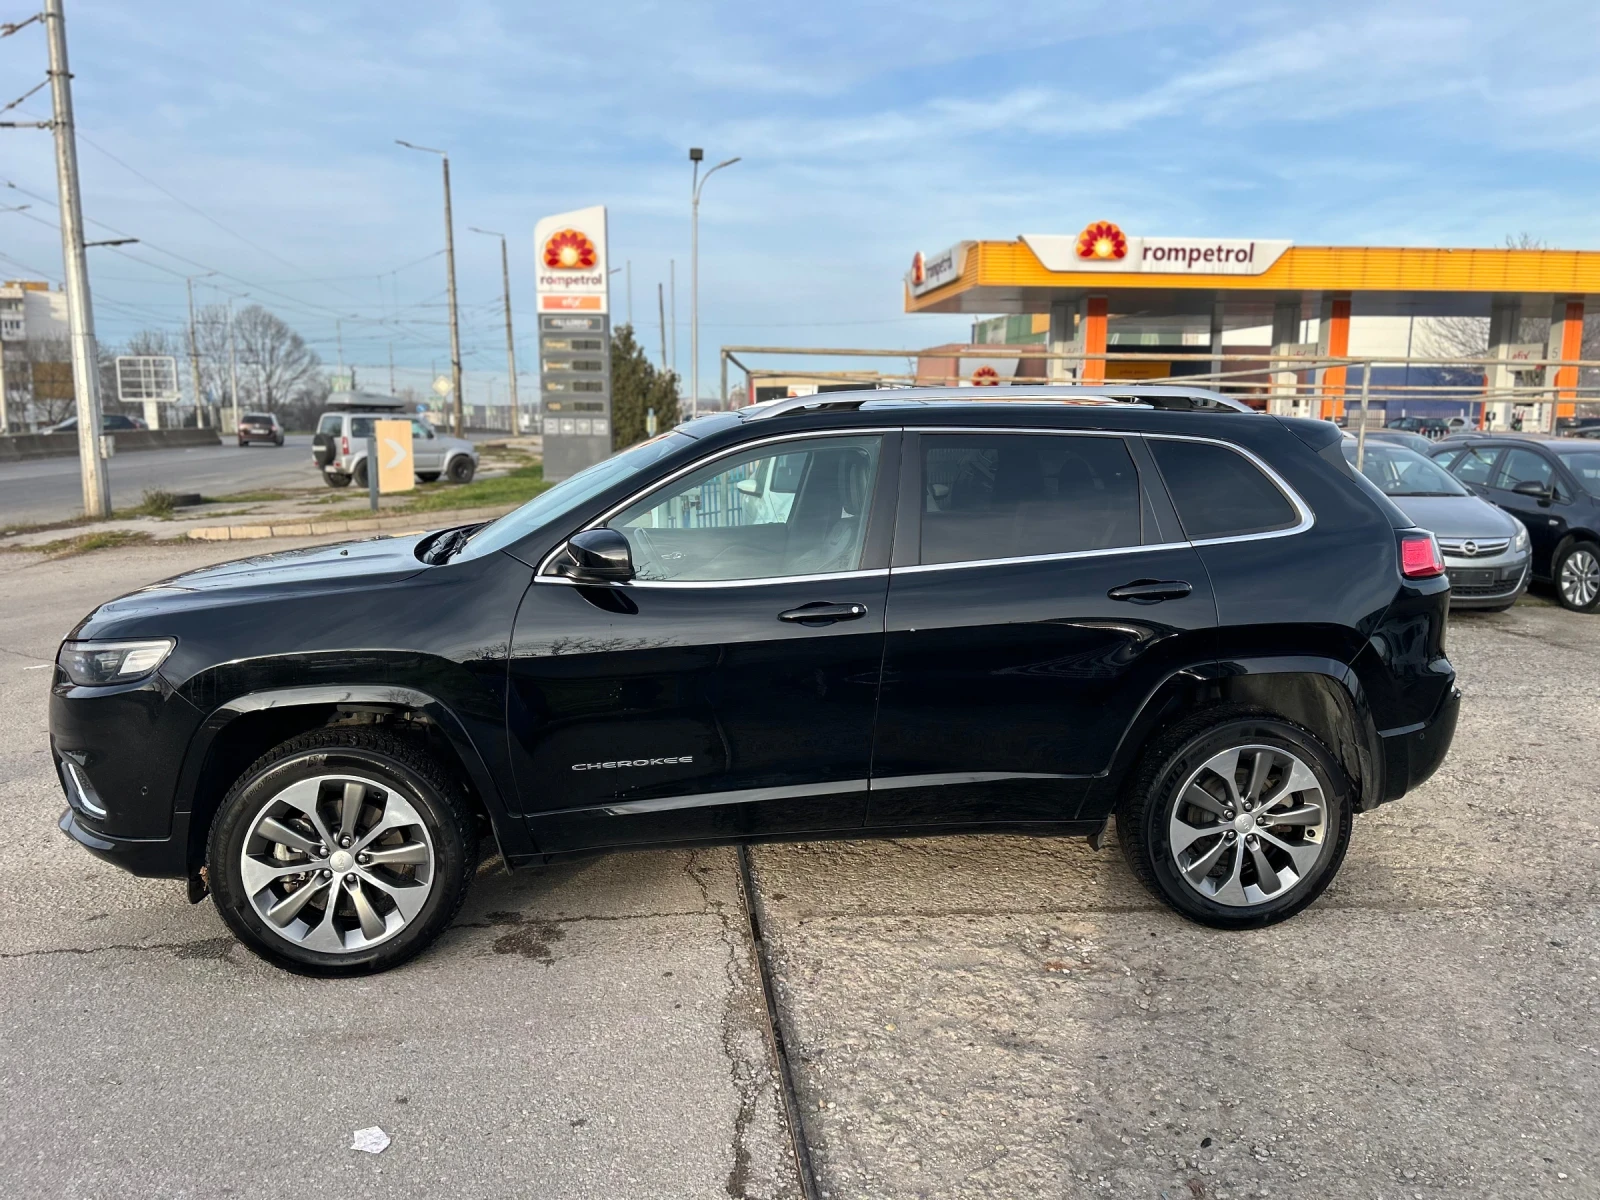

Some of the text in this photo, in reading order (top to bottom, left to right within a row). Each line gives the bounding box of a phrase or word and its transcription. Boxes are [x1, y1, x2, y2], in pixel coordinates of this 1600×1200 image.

[1142, 241, 1254, 269] rompetrol
[540, 273, 602, 289] rompetrol
[1551, 347, 1559, 359] 5
[571, 756, 693, 771] CHEROKEE
